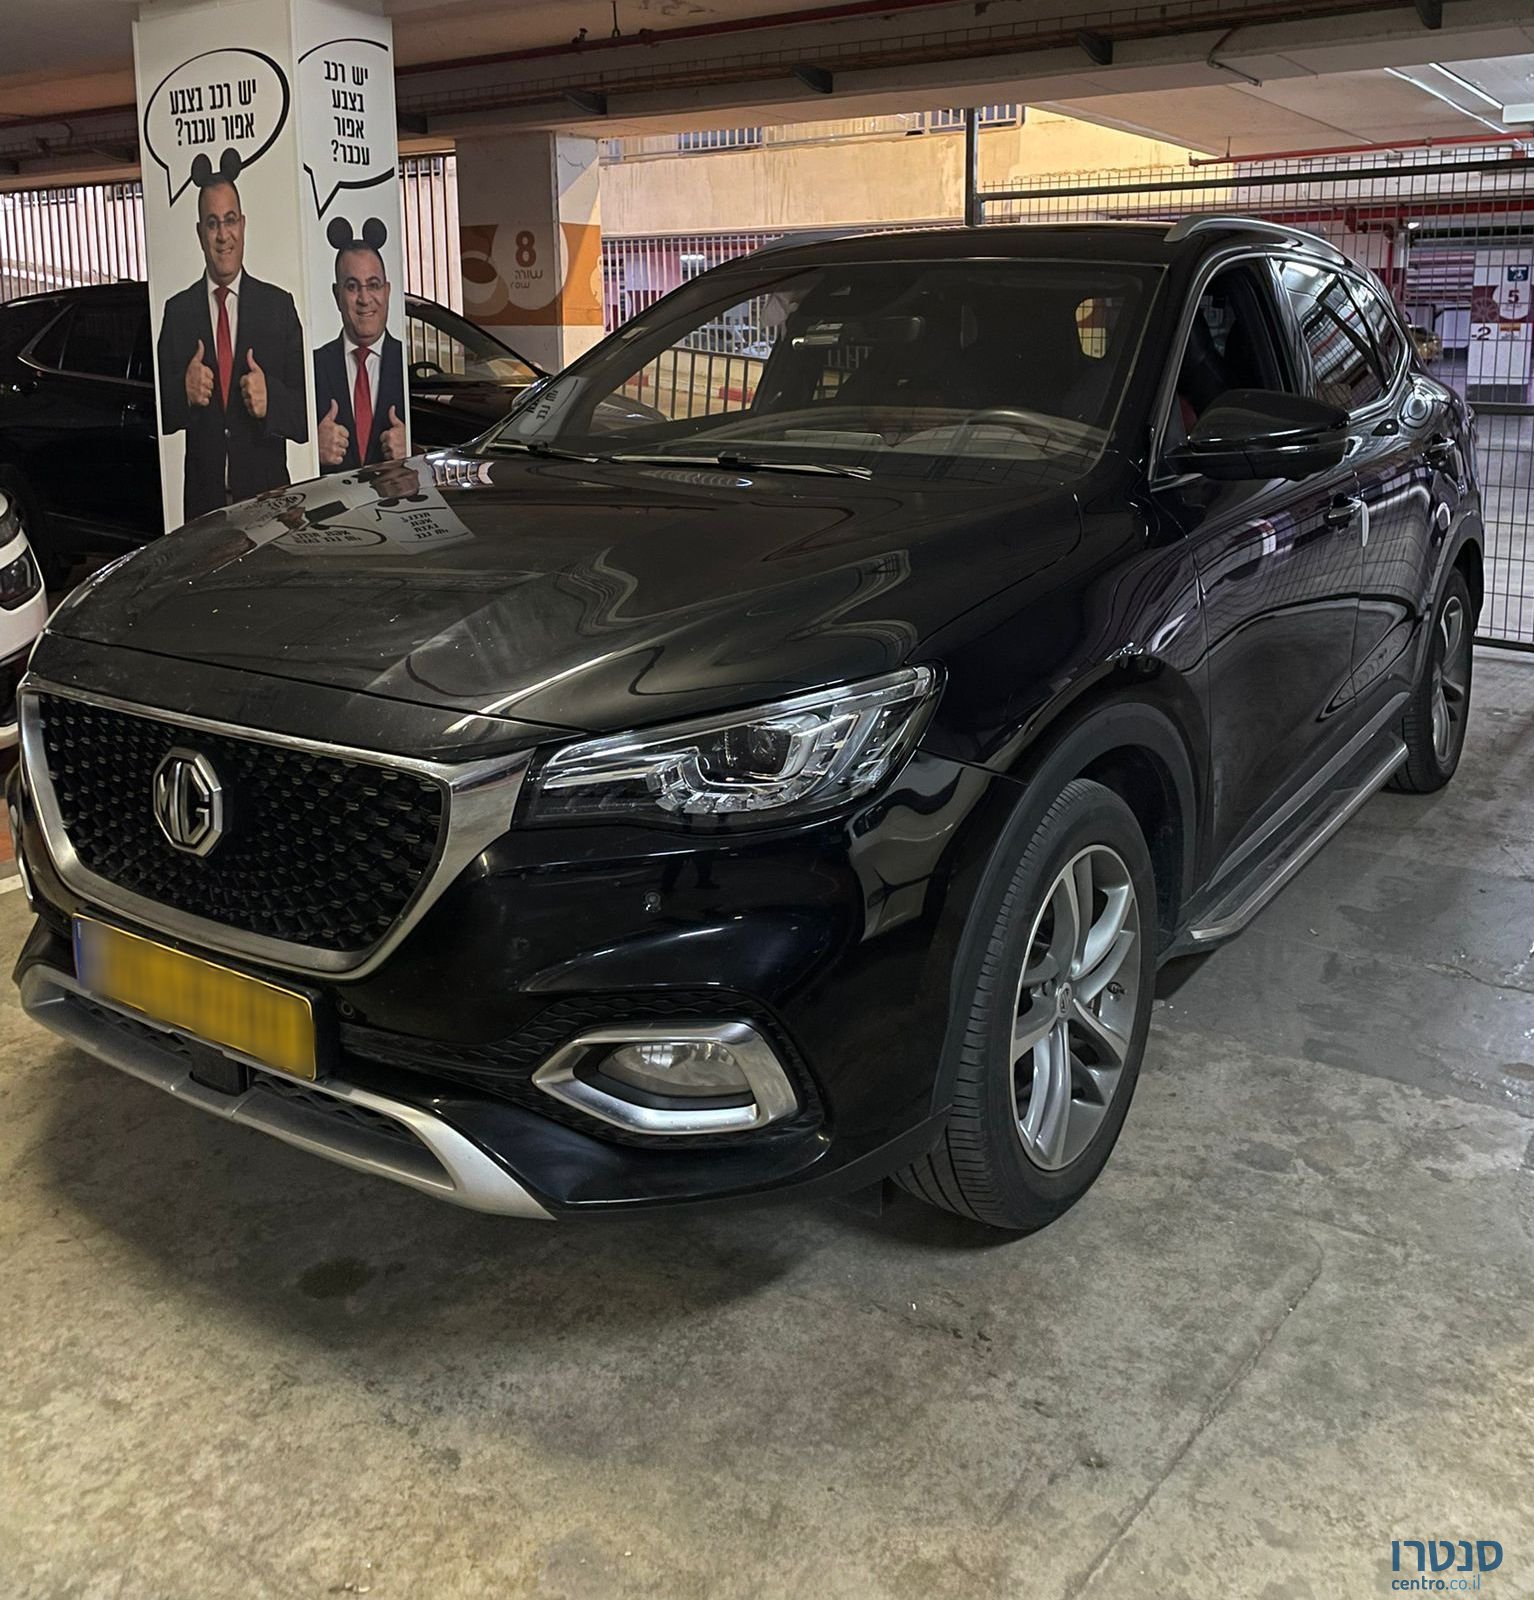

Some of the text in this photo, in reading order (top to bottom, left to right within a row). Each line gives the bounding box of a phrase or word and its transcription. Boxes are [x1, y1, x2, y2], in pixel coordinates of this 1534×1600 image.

[323, 60, 369, 86] יש רכב
[170, 79, 257, 115] יש רכב בצבע
[331, 89, 365, 113] בצבע
[175, 113, 255, 146] אפור עכבר?
[334, 116, 365, 140] אפור
[331, 140, 371, 166] עכבר?
[515, 230, 537, 268] 8
[510, 281, 530, 289] row
[514, 270, 543, 279] שורה
[1508, 289, 1520, 304] 5
[156, 758, 211, 846] MG
